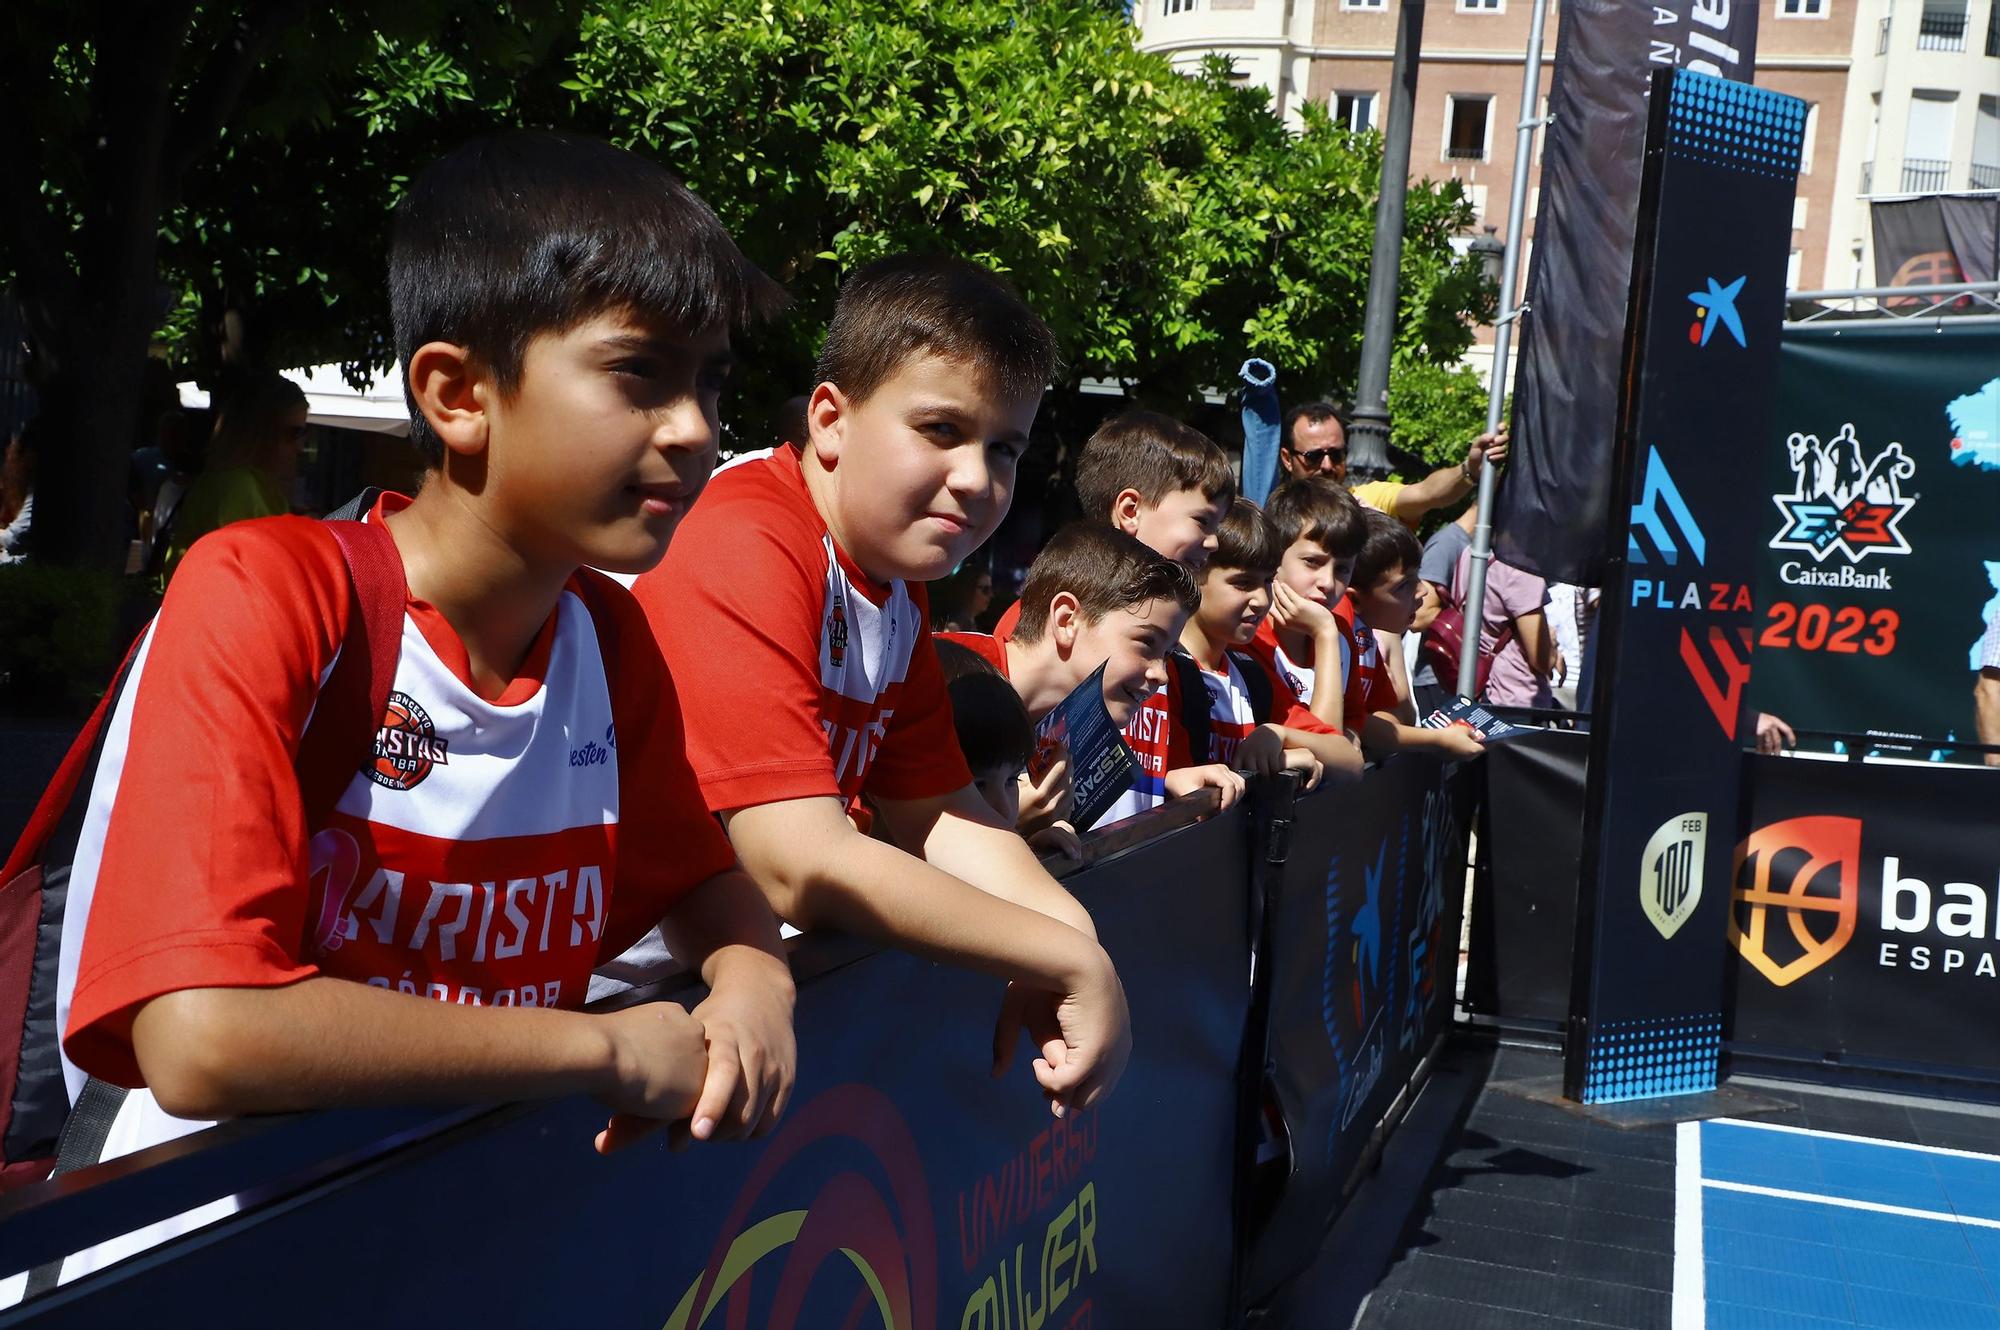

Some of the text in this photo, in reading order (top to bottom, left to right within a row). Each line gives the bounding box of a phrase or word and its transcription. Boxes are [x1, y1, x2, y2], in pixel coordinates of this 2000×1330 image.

[1644, 6, 1681, 96] AÑ
[1780, 561, 1892, 590] CaixaBank
[1632, 579, 1753, 611] PLAZA
[1759, 602, 1899, 656] 2023
[568, 740, 608, 769] esten
[1682, 820, 1702, 832] FEB
[1881, 856, 2000, 940] ba
[1879, 942, 1997, 978] ESPA
[960, 1181, 1098, 1330] MUJER
